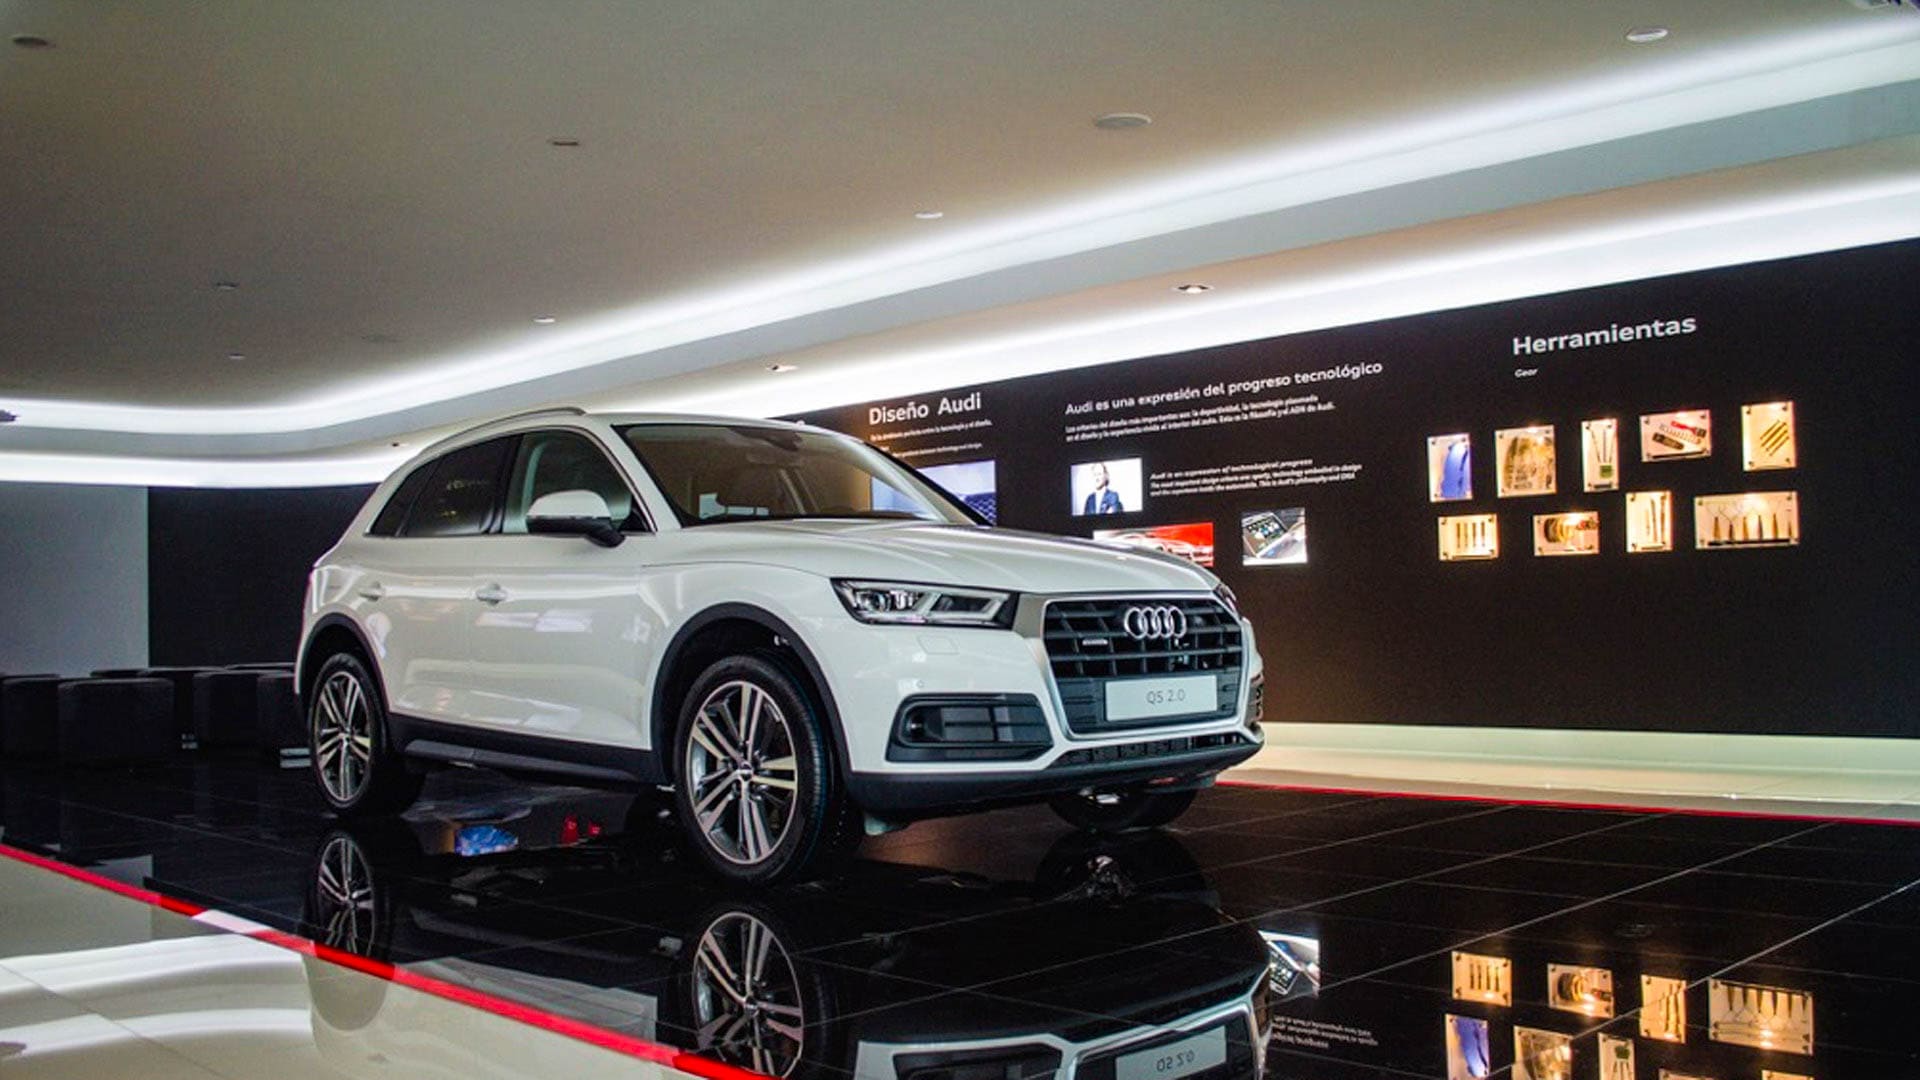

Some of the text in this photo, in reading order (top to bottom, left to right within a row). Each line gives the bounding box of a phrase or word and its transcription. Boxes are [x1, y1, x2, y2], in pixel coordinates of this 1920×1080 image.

[1513, 318, 1697, 355] Herramientas
[1065, 362, 1383, 415] Audi es una expresión del progreso tecnológico
[868, 392, 981, 425] Diseño Audi
